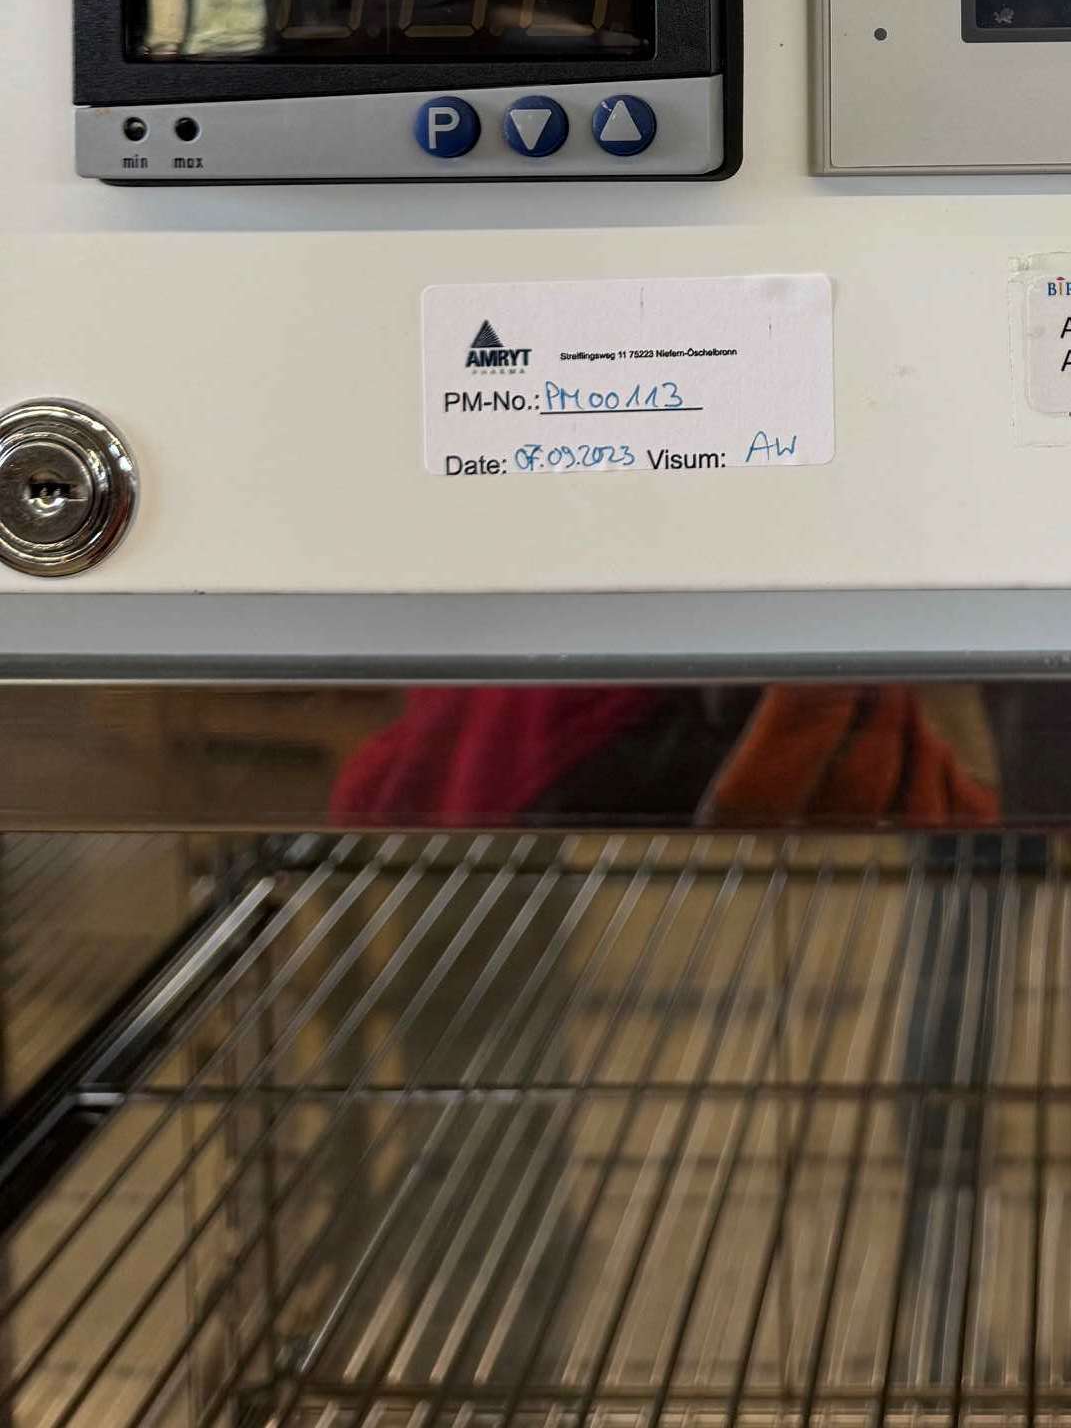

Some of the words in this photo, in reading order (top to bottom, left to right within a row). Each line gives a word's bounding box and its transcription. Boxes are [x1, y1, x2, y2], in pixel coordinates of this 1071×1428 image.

[428, 106, 461, 150] P
[123, 154, 148, 169] min
[174, 157, 204, 169] max
[465, 348, 533, 368] AMRYT
[629, 350, 654, 359] 75223
[444, 390, 540, 413] PM-No.:
[545, 380, 684, 411] PM00113
[445, 454, 508, 477] Date:
[646, 448, 726, 471] Visum:
